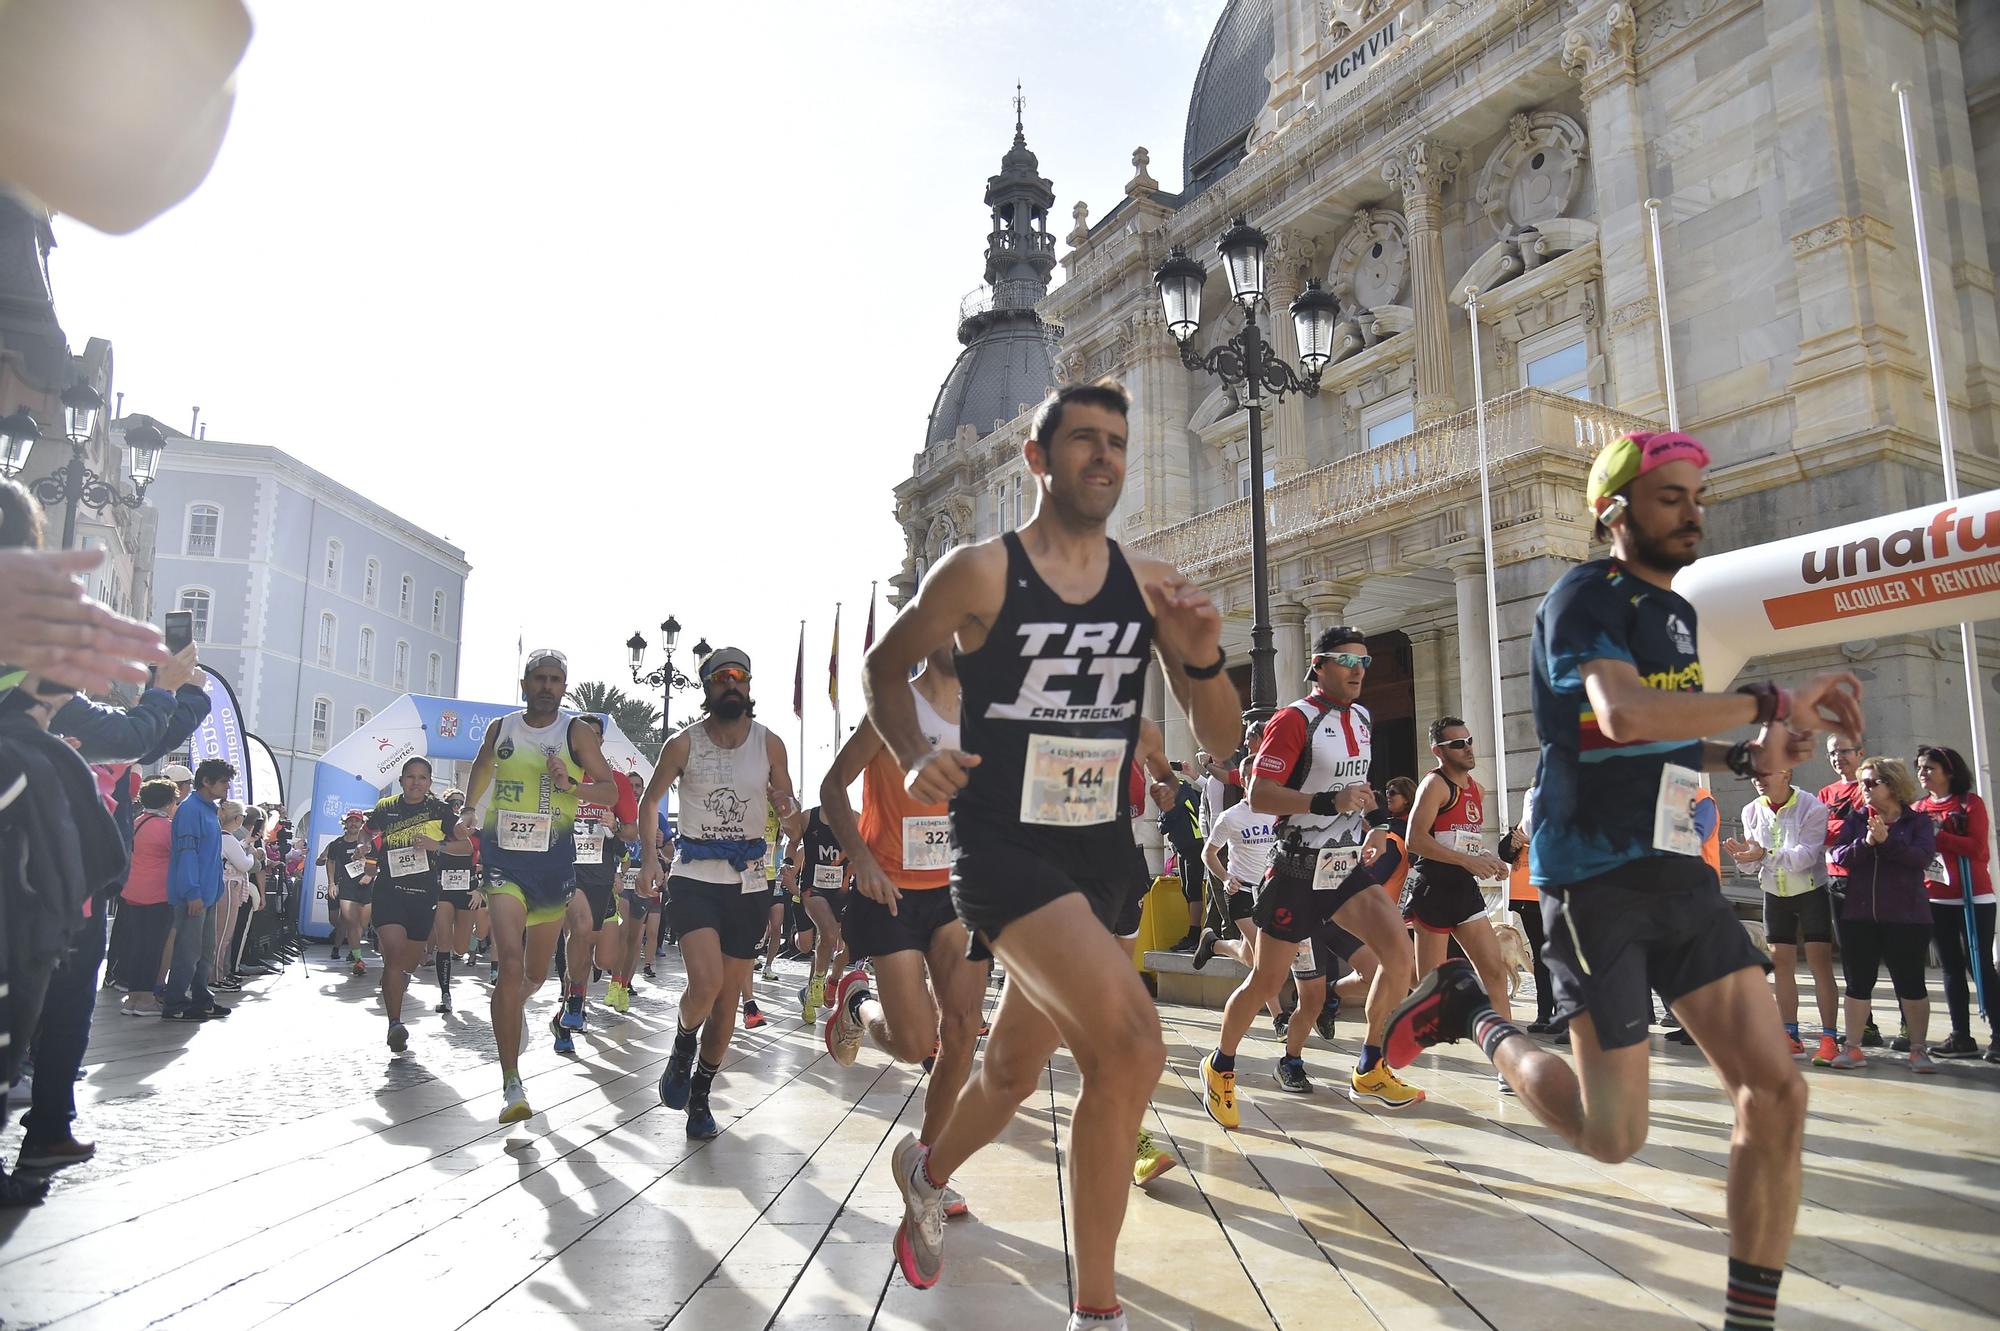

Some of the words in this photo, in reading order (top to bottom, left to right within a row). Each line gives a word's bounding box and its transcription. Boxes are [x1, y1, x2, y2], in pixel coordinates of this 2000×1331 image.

[1325, 22, 1394, 90] MCMVII
[1833, 580, 1909, 613] ALQUILER
[1911, 576, 1929, 597] Y
[1016, 622, 1142, 657] TRI
[379, 746, 415, 774] Deportes
[1334, 760, 1368, 778] UNED
[1063, 766, 1105, 788] 144
[510, 822, 536, 833] 237
[577, 842, 595, 851] 293
[1242, 837, 1276, 845] UNIVERSID
[399, 854, 417, 863] 261
[1334, 860, 1347, 872] 80
